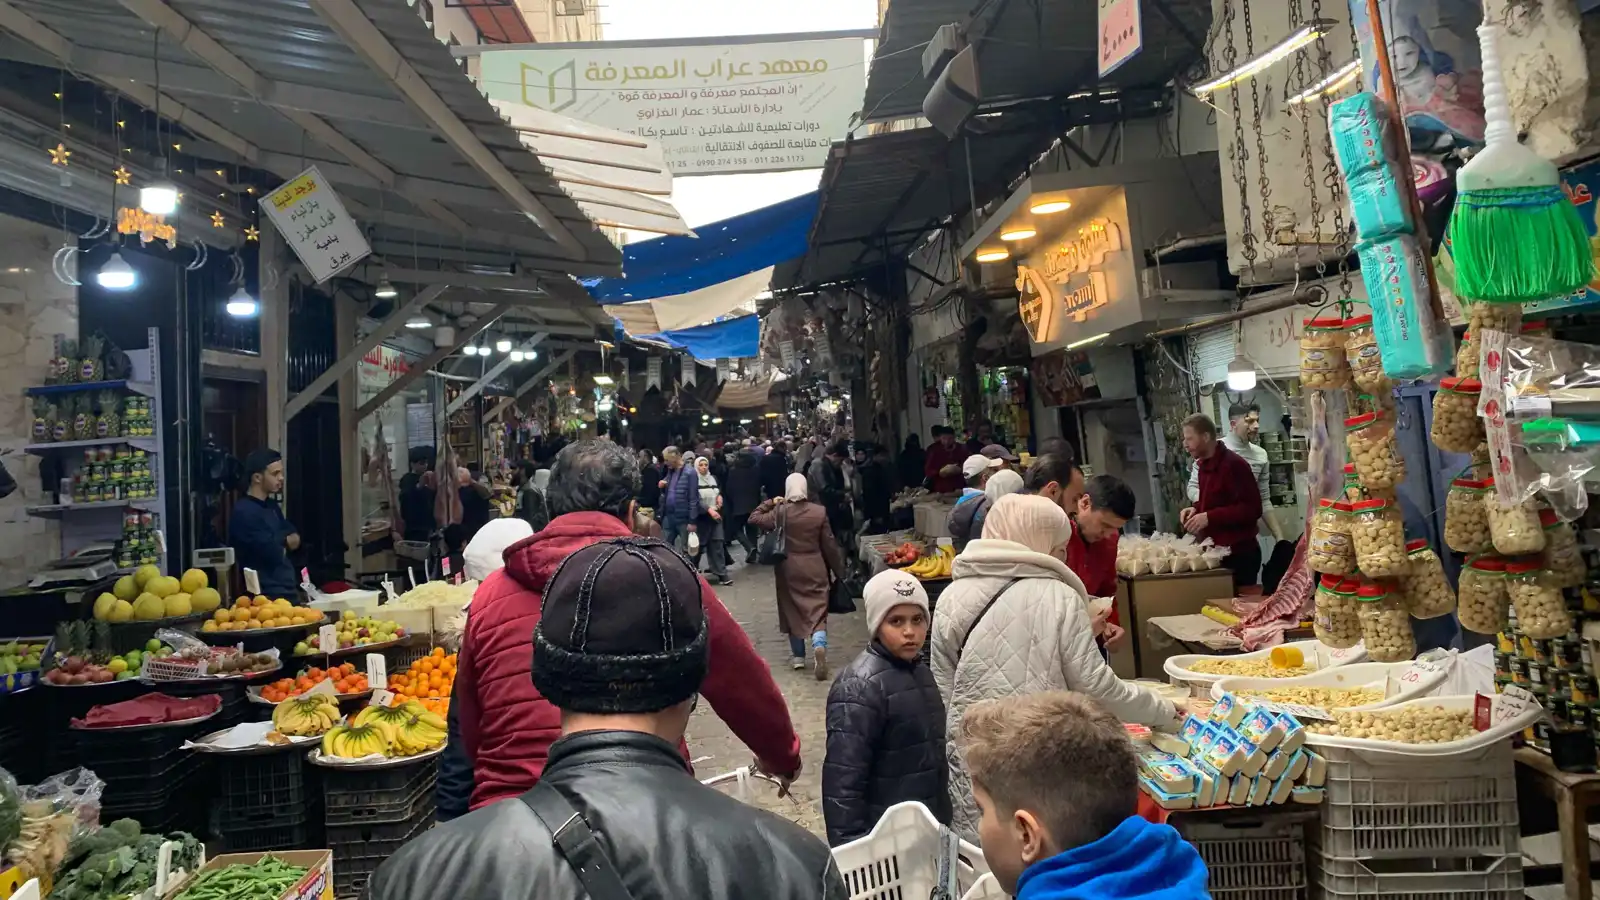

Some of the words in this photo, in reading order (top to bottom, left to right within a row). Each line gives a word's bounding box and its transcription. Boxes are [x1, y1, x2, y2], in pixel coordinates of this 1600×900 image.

[585, 58, 686, 84] المعرفة
[759, 58, 828, 76] معهد
[618, 91, 640, 103] قوة
[642, 89, 687, 101] المعرفة
[690, 91, 698, 100] و
[700, 88, 736, 99] معرفة
[740, 85, 785, 99] المجتمع
[637, 107, 677, 120] الغزاوي
[681, 107, 704, 118] عمار
[660, 125, 688, 139] تاسع
[699, 123, 753, 136] للشهادتين
[756, 121, 792, 134] تعليمية
[793, 120, 820, 132] دورات
[705, 141, 745, 154] الانتقالية
[747, 139, 785, 152] للصفوف
[787, 138, 817, 150] متابعة
[697, 159, 715, 167] 0990
[295, 180, 317, 196] يوجد
[272, 191, 292, 208] لدينا
[319, 209, 336, 228] فول
[313, 234, 339, 250] بامية
[330, 251, 351, 270] يبرق
